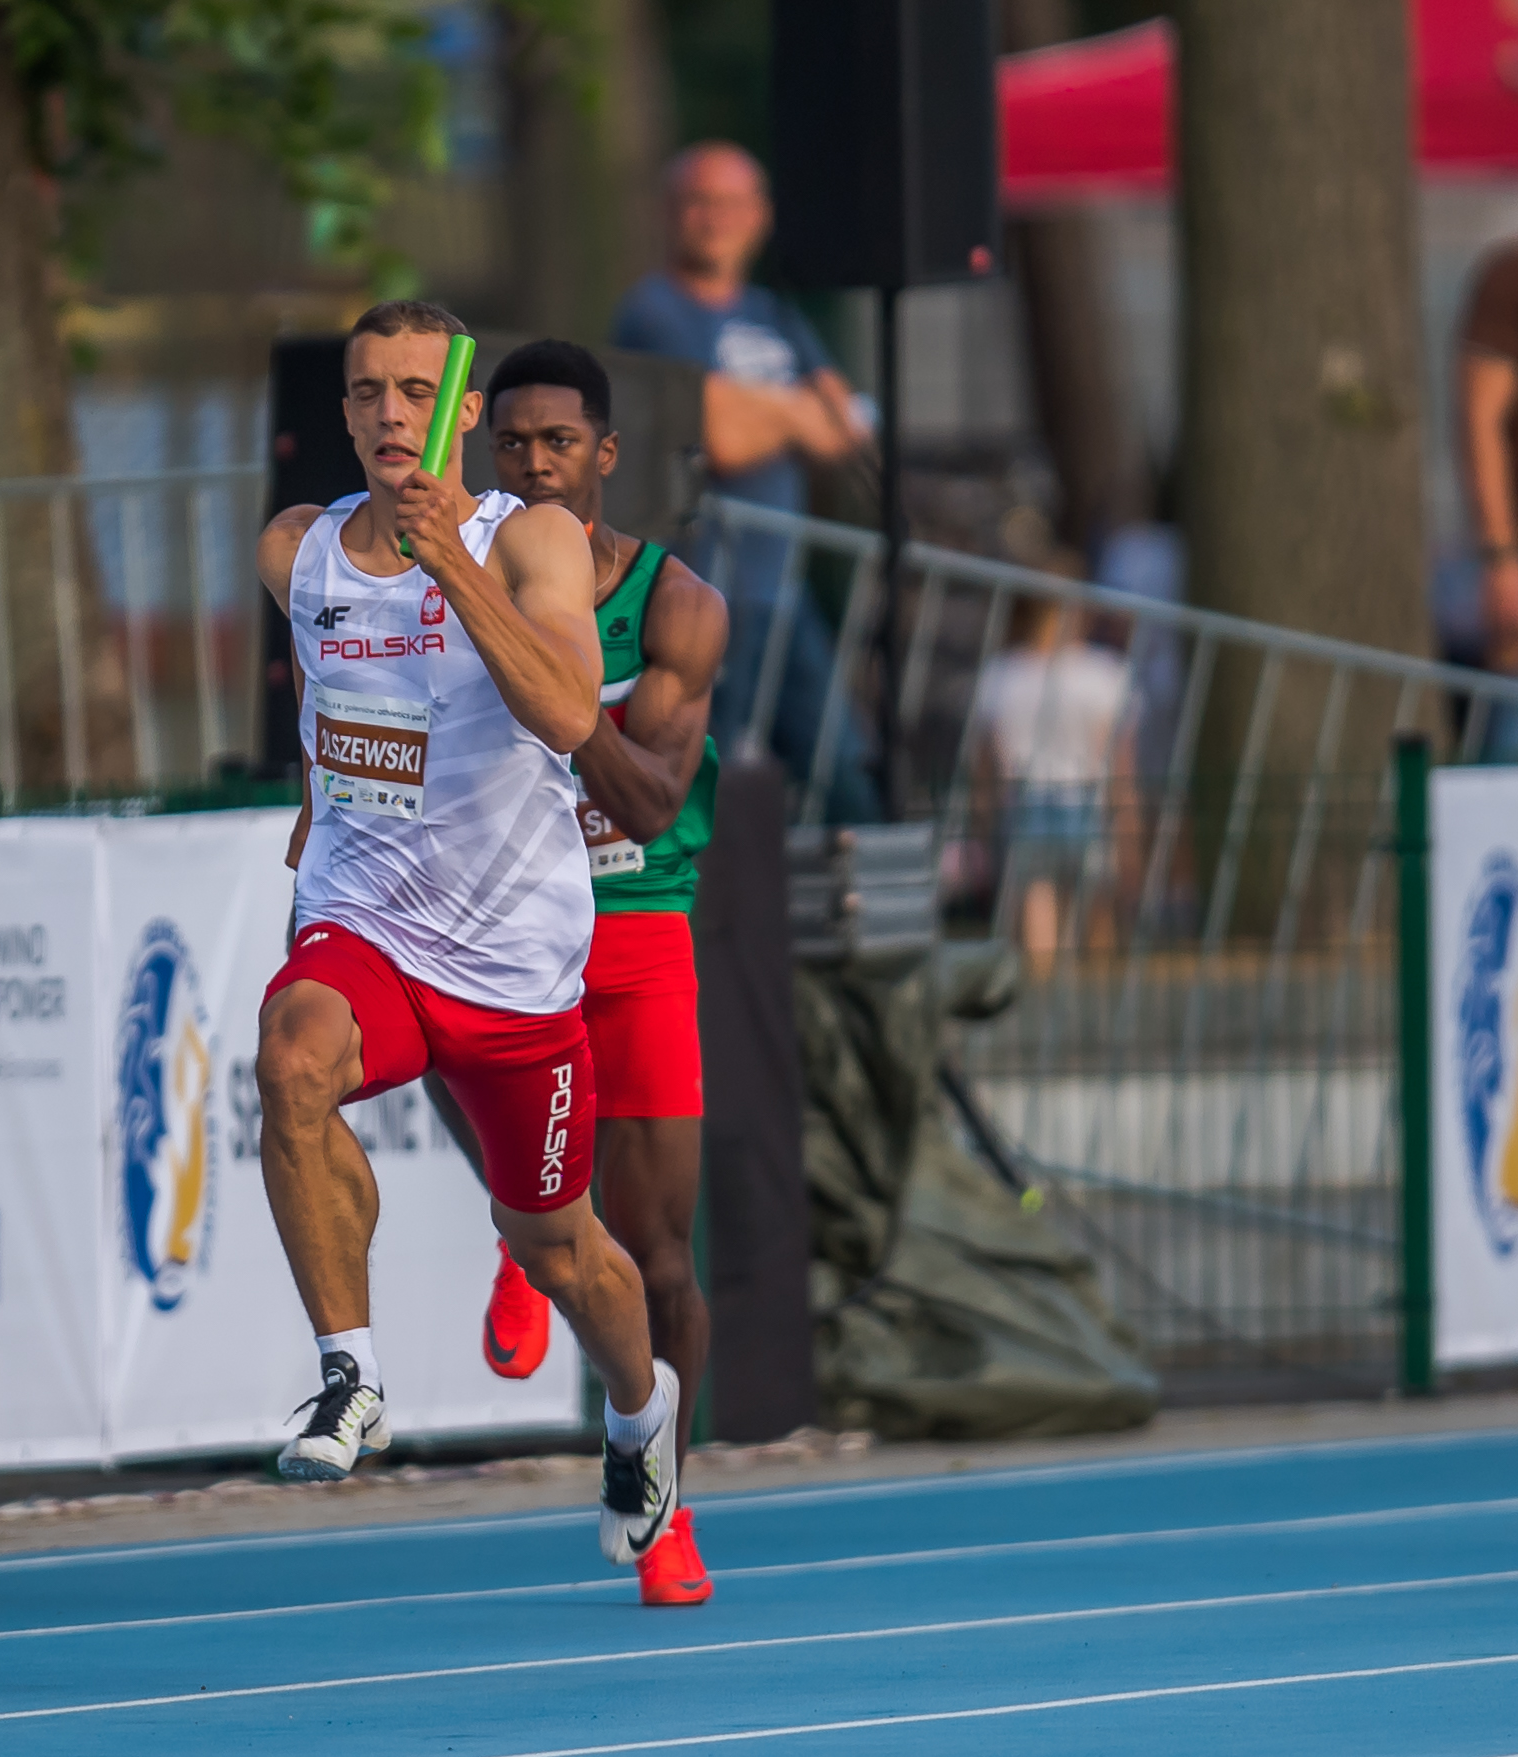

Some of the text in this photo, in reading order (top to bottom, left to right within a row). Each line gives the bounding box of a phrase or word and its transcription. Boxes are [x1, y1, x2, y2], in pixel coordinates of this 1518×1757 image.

[313, 606, 351, 630] 4F
[320, 633, 446, 660] POLSKA
[539, 1062, 572, 1196] POLSKA
